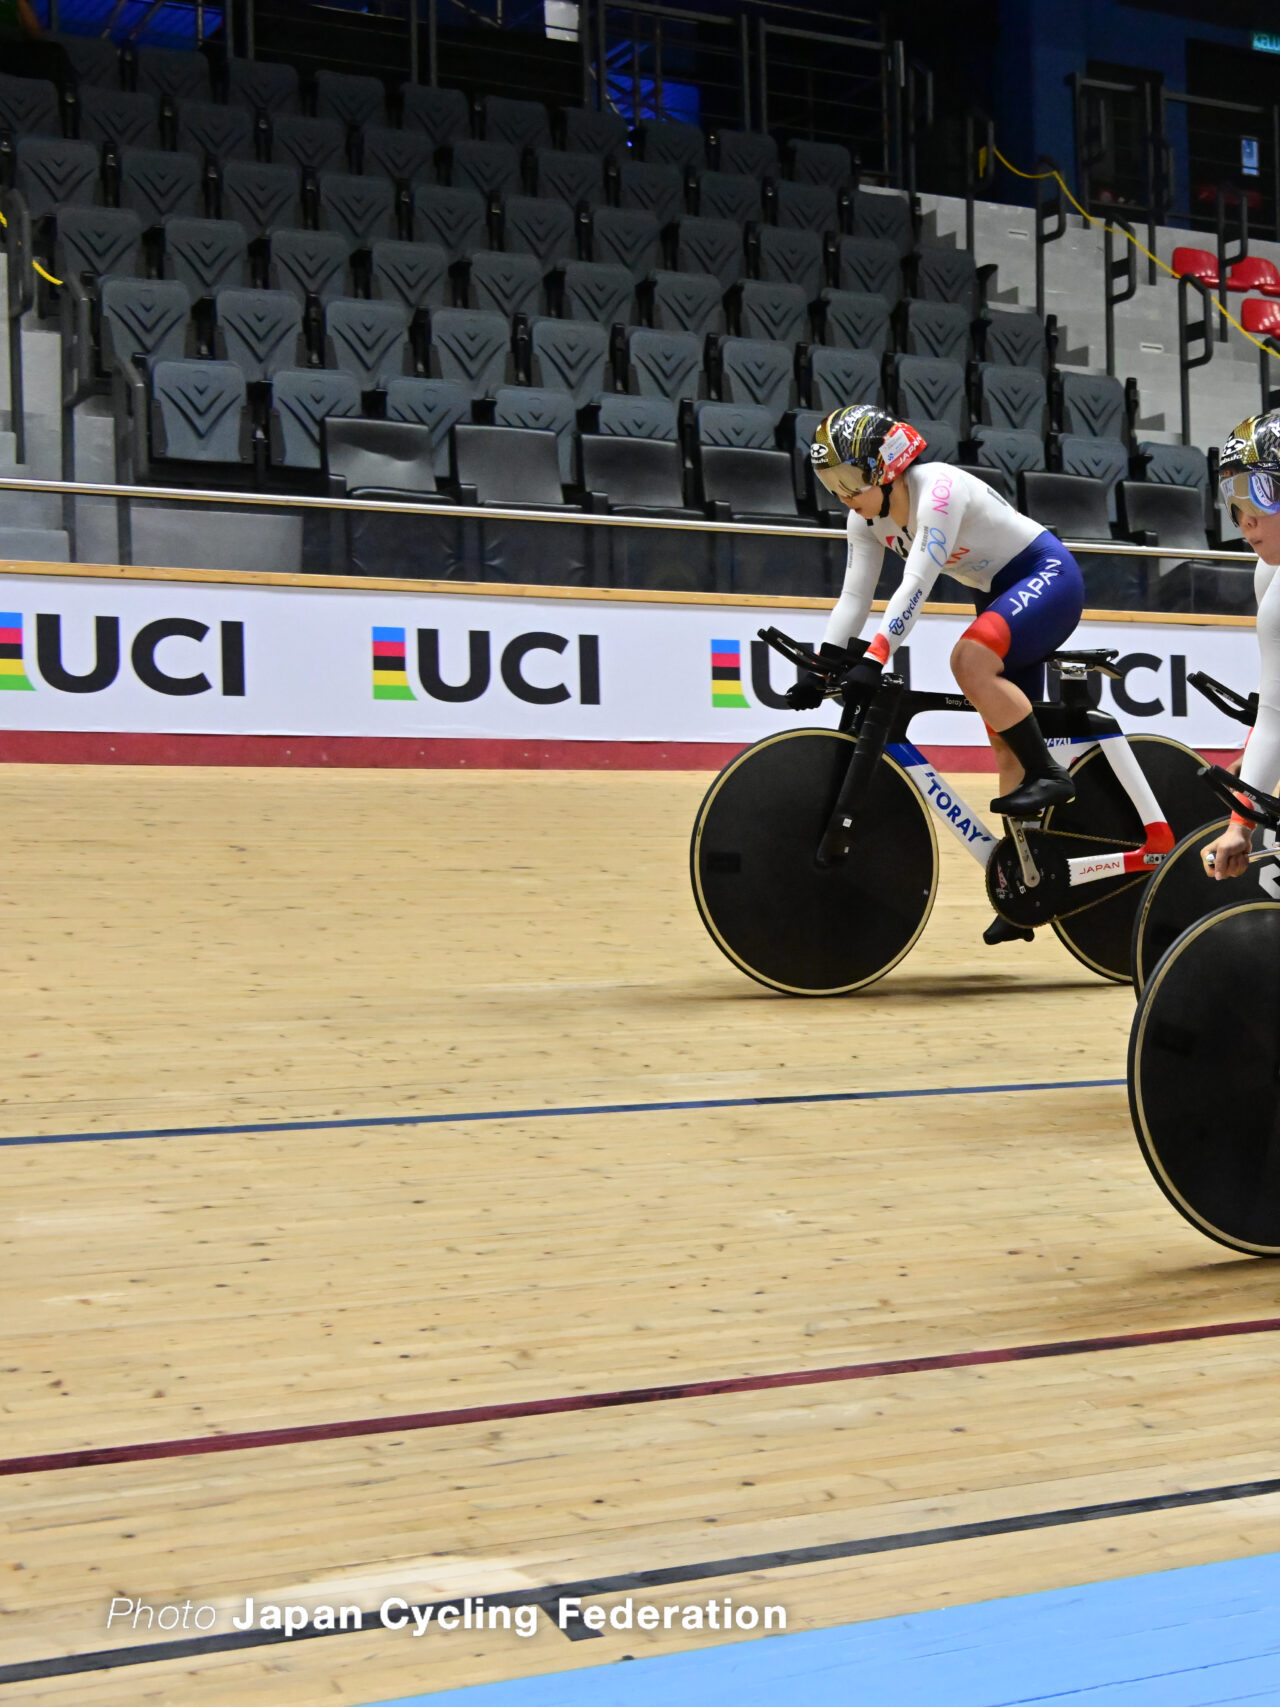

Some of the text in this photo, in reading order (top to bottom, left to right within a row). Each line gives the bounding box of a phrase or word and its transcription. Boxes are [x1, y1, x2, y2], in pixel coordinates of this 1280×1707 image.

[896, 435, 923, 467] JAPAN
[1009, 558, 1062, 617] JAPAN
[902, 588, 923, 621] Cyclers
[36, 613, 246, 696] UCI
[417, 628, 601, 706] UCI
[945, 697, 963, 707] Toray
[1079, 861, 1120, 875] JAPAN
